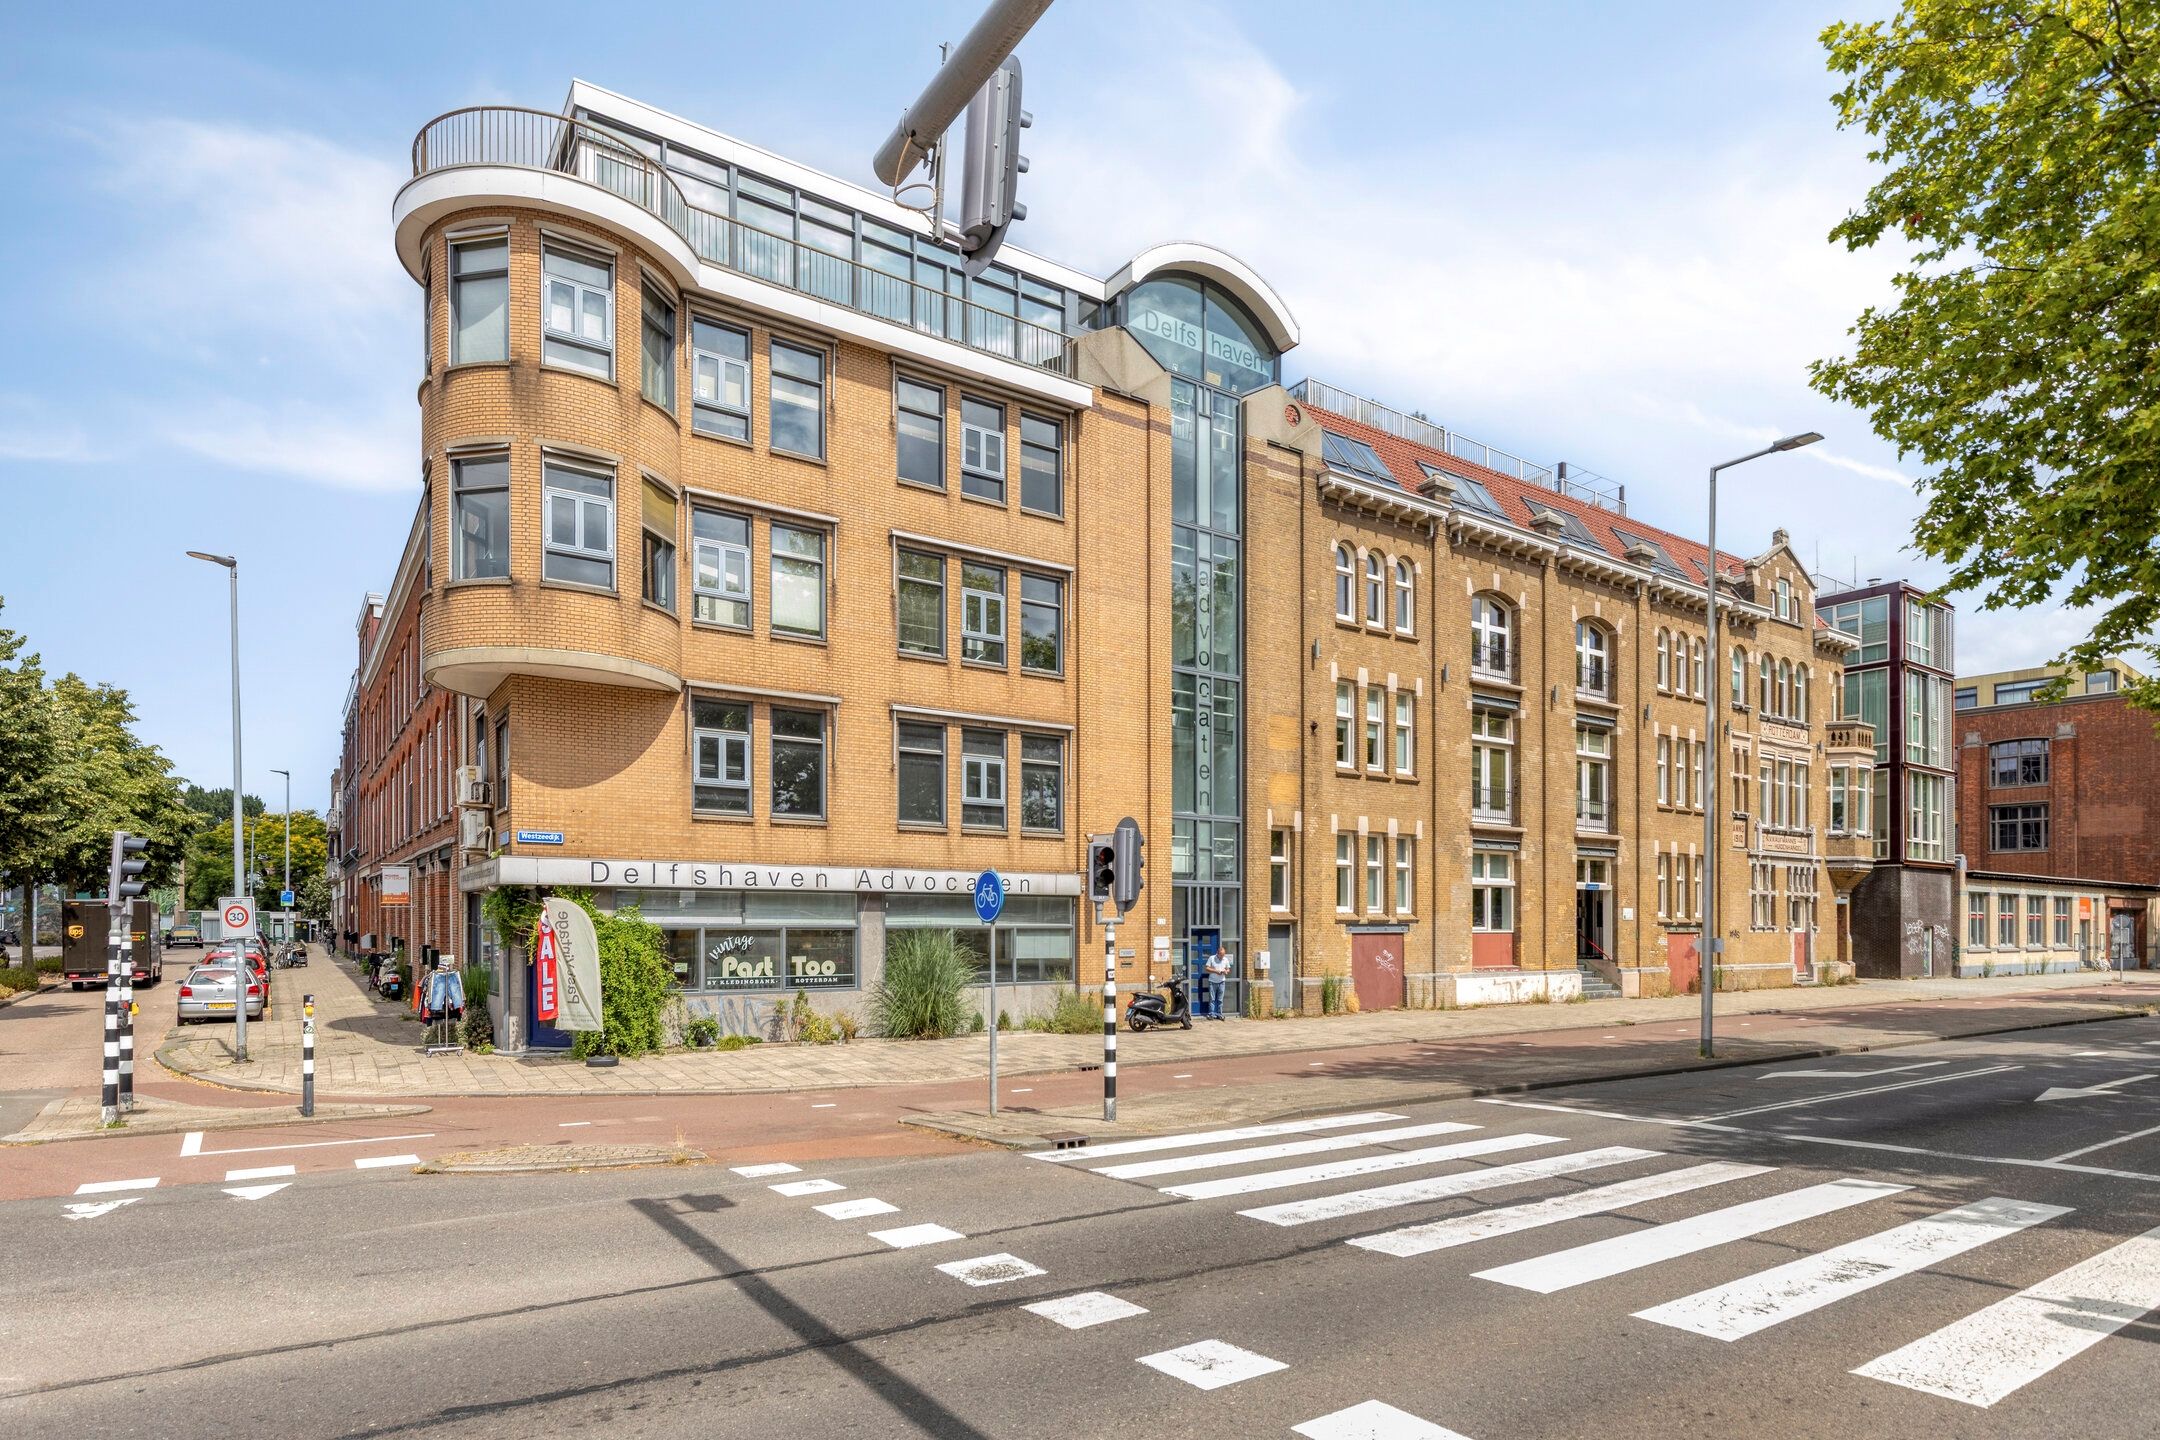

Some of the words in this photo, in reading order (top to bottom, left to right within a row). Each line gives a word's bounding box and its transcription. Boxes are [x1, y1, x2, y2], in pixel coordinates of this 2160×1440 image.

[1768, 725, 1800, 740] ROTTERDAM
[521, 832, 560, 842] Westzeedijk
[590, 861, 828, 888] Delfshaven
[856, 869, 1031, 893] Advocaen
[229, 912, 245, 922] 30
[69, 929, 84, 937] ups
[708, 935, 755, 961] vintage
[540, 908, 555, 1011] SALE
[722, 956, 773, 977] Past
[791, 956, 836, 976] Too
